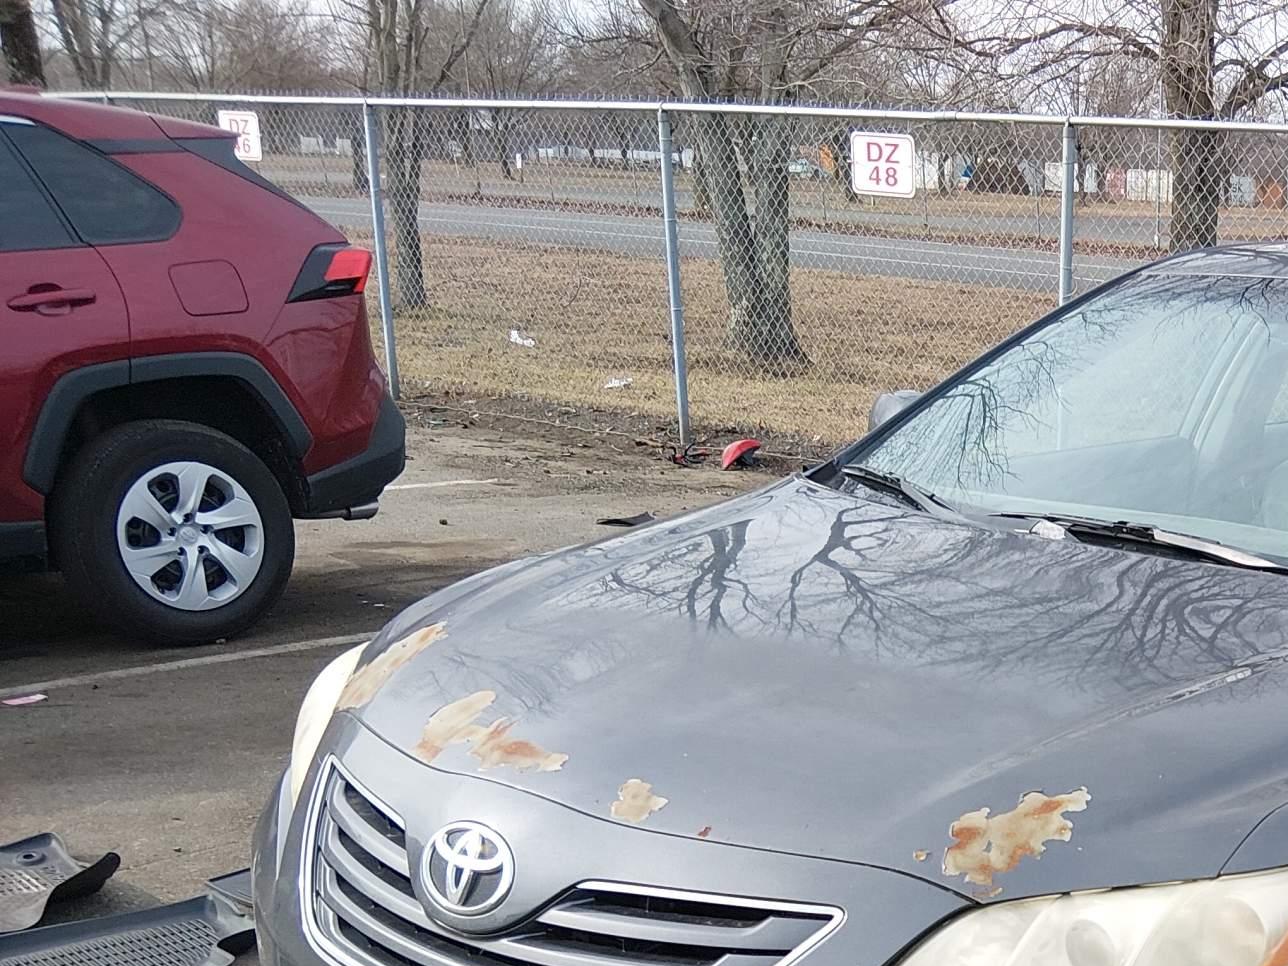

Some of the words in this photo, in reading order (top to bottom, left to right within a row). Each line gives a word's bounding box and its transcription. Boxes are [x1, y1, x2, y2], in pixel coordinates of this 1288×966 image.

[229, 119, 251, 135] DZ
[866, 141, 900, 164] DZ
[869, 165, 898, 187] 48
